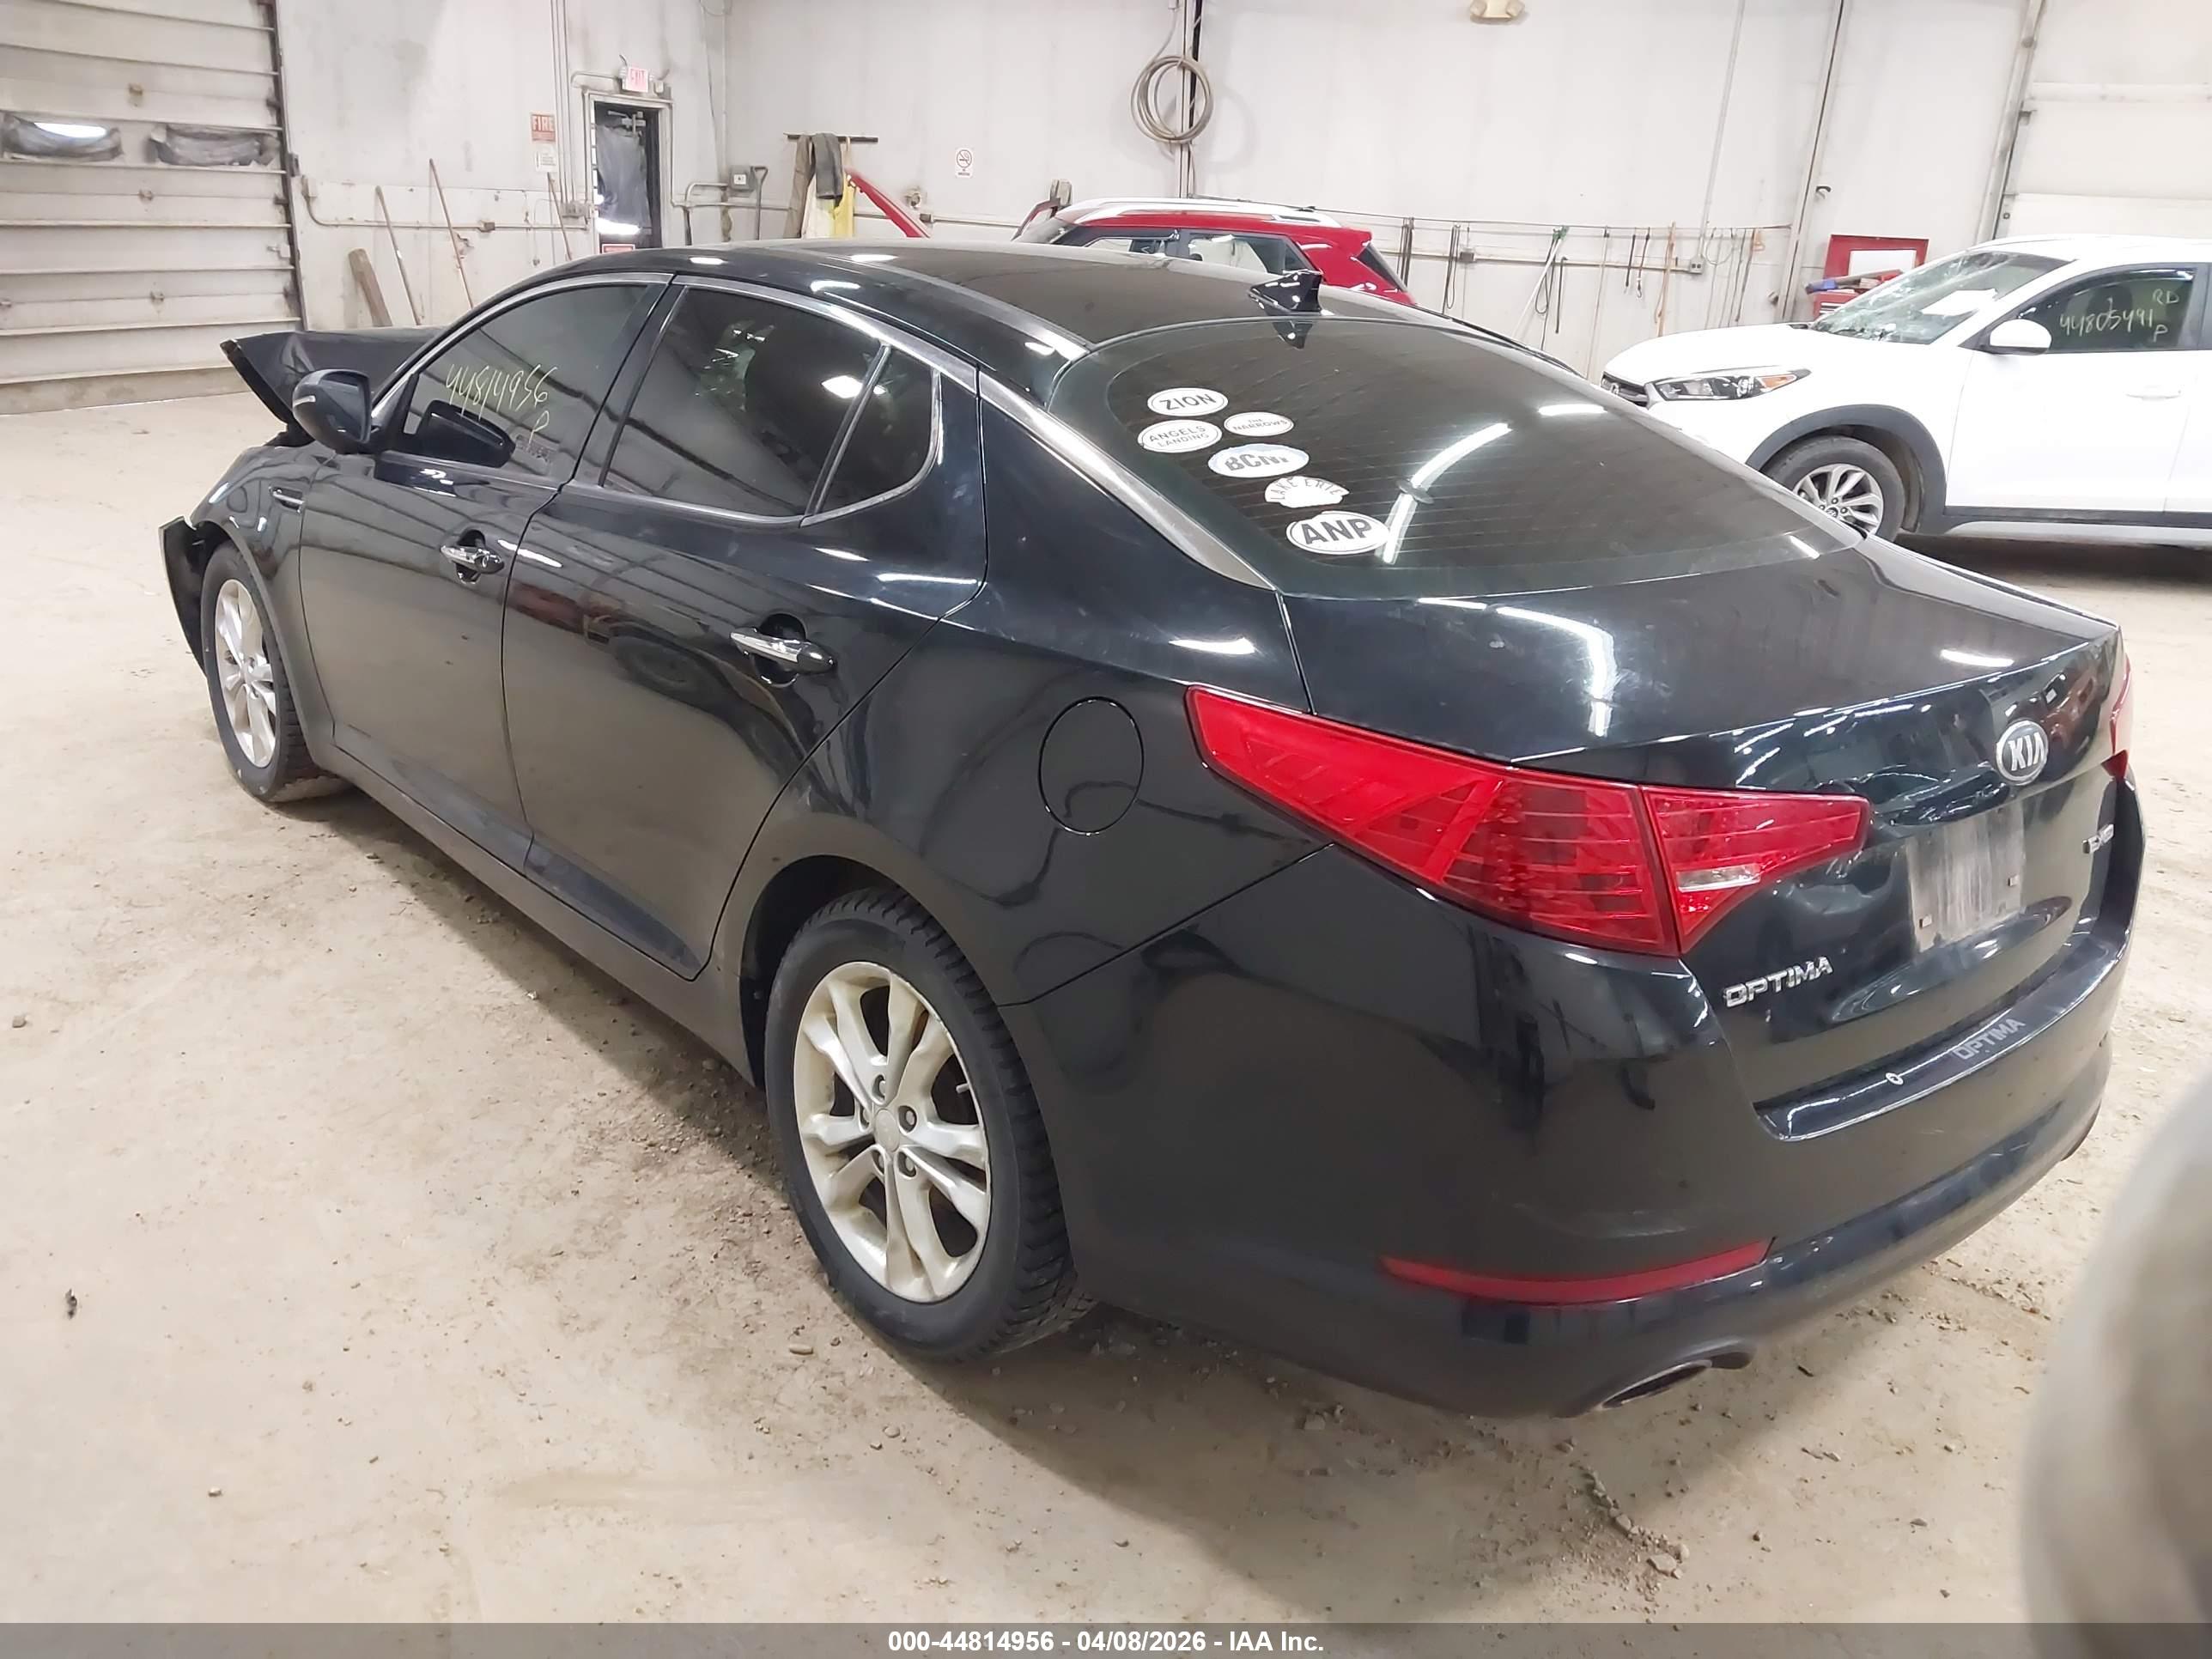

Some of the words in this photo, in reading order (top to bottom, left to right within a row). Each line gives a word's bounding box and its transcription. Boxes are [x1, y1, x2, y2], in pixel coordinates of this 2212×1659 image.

[629, 68, 645, 84] EXIT
[532, 115, 554, 131] FIRE
[2154, 324, 2168, 343] P
[446, 364, 558, 421] 44814956
[1159, 393, 1217, 410] ZION
[526, 410, 550, 447] P
[1149, 425, 1206, 442] ANGELS
[1233, 420, 1288, 431] NARROWS
[1157, 433, 1210, 447] LANDING
[1270, 477, 1299, 501] LAKE
[1304, 478, 1346, 495] ERIE
[1301, 519, 1372, 545] ANP
[2008, 732, 2045, 771] KIA
[1723, 956, 1833, 1008] OPTIMA
[1952, 1018, 2026, 1060] OPTIMA
